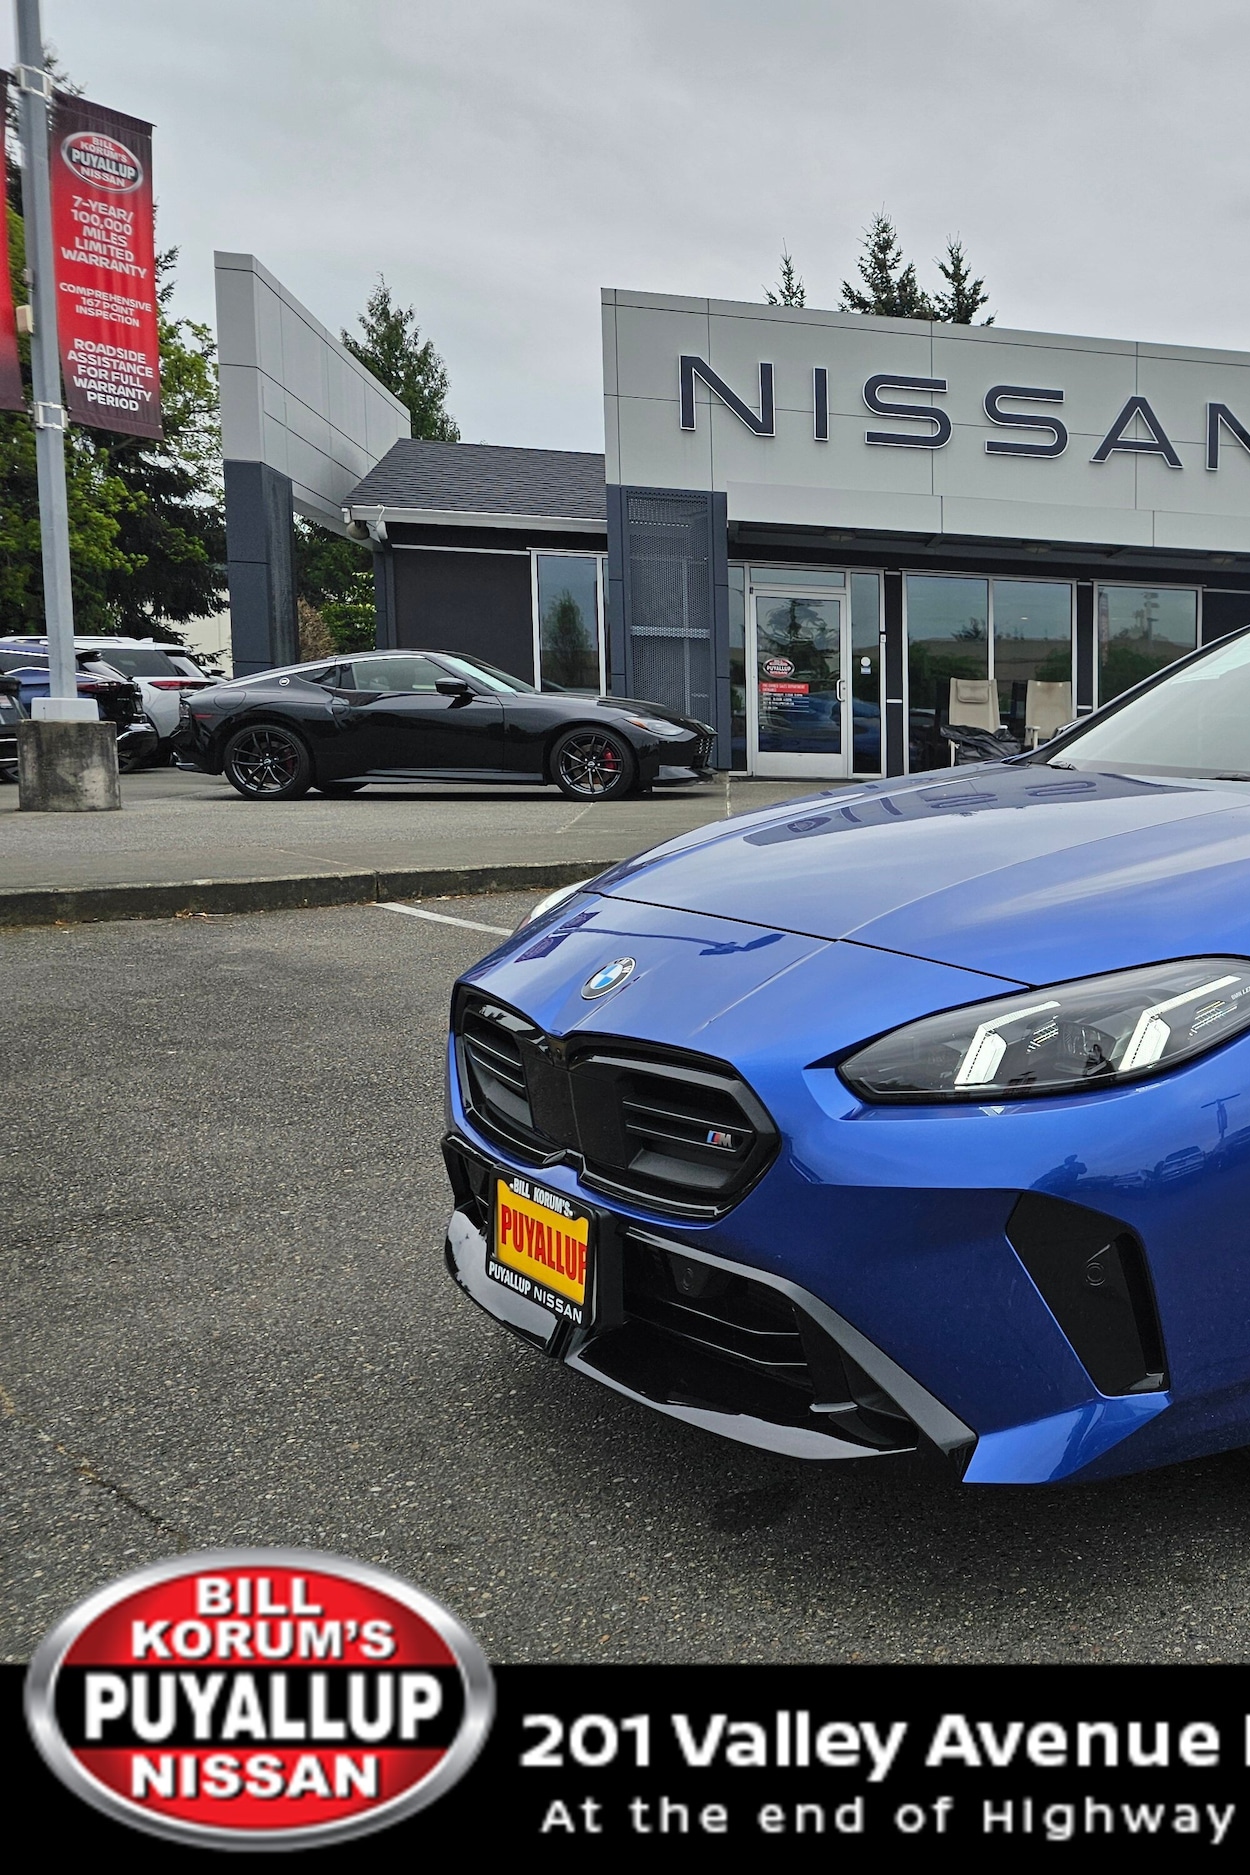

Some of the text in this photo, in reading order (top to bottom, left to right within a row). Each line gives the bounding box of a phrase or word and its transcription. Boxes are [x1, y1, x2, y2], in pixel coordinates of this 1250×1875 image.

[80, 141, 128, 163] KORUM'S
[92, 136, 114, 151] BILL
[72, 149, 136, 180] PUYALLUP
[81, 167, 125, 188] NISSAN
[71, 209, 132, 236] 100,000
[72, 195, 134, 223] 7-YEAR/
[75, 237, 134, 263] LIMITED
[83, 225, 127, 248] MILES
[61, 247, 147, 279] WARRANTY
[59, 282, 152, 313] COMPREHENSIVE
[81, 297, 135, 317] 167 POINT
[75, 305, 140, 327] INSPECTION
[67, 350, 153, 378] ASSISTANCE
[74, 338, 146, 365] ROADSIDE
[73, 375, 152, 402] WARRANTY
[77, 364, 144, 389] FOR FULL
[87, 391, 139, 411] PERIOD
[512, 1177, 572, 1217] BILL KORUM'S
[489, 1261, 582, 1325] PUYALLUP NISSAN
